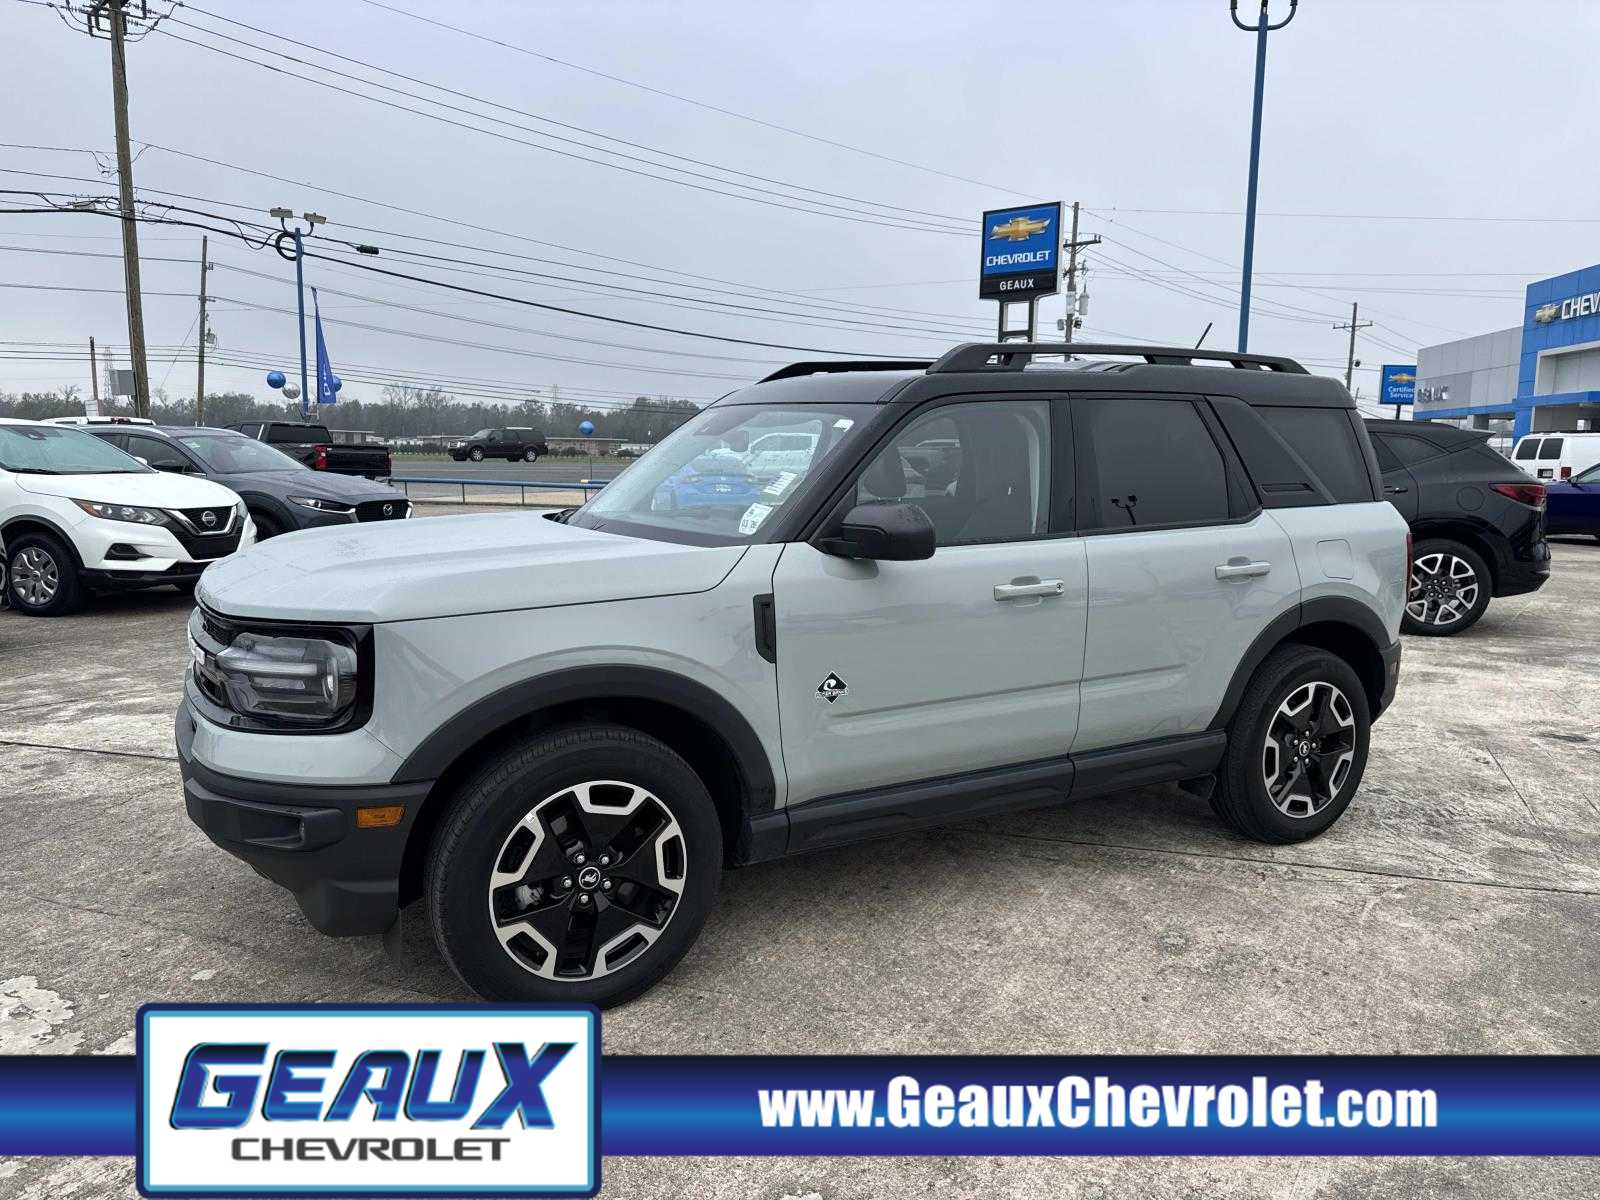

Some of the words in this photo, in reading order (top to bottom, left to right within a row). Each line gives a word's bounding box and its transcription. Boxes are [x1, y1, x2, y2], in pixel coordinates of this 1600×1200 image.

[986, 250, 1051, 267] CHEVROLET
[1000, 278, 1034, 291] GEAUX
[1561, 291, 1600, 320] CHEV
